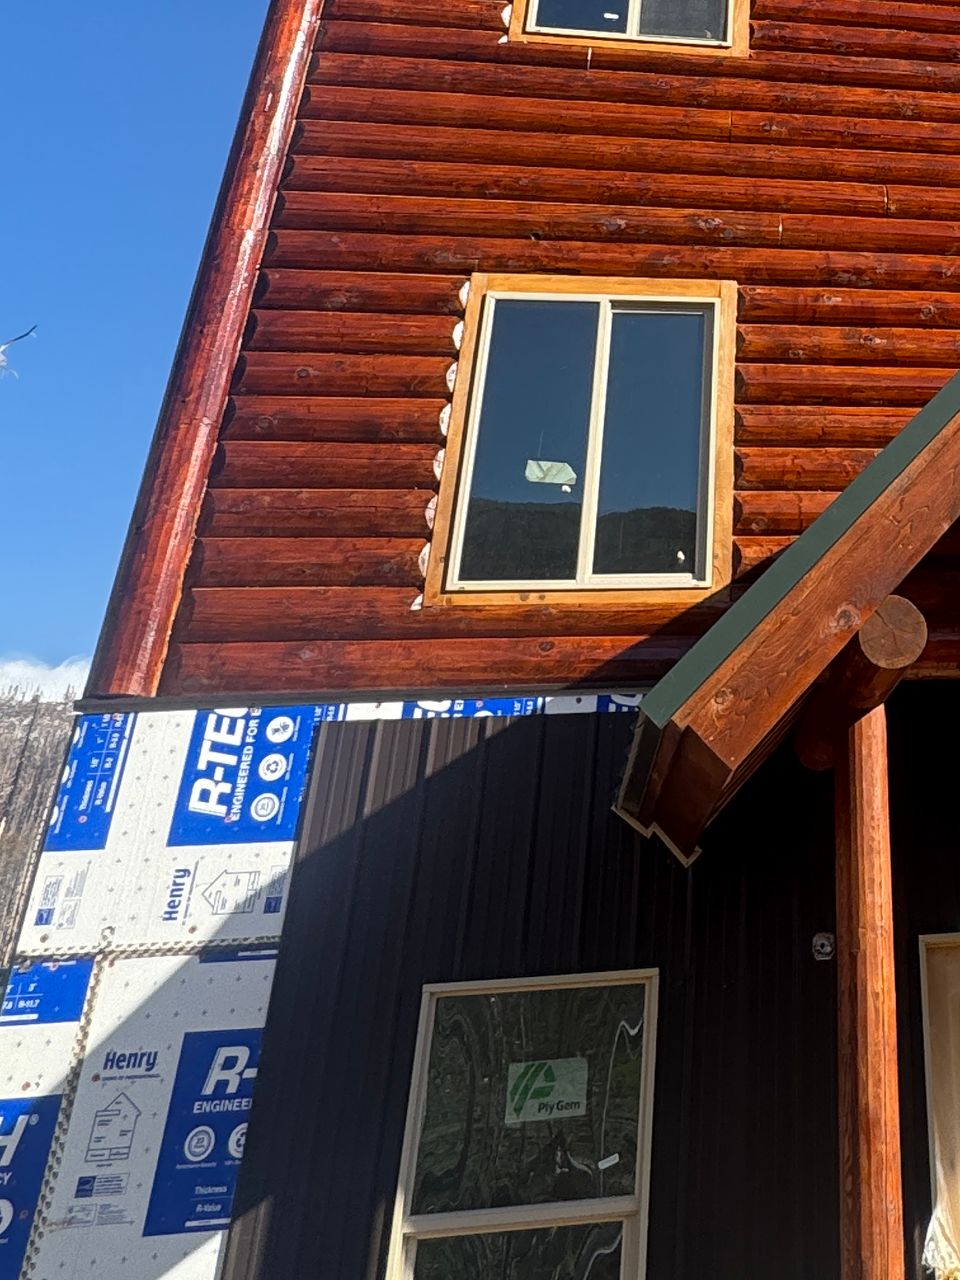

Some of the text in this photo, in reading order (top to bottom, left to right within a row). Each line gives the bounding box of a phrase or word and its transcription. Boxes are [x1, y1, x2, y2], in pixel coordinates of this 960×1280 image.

[188, 707, 248, 818] R-TE
[228, 745, 254, 821] ENGINEERED
[245, 718, 260, 743] FOR
[162, 868, 191, 921] Henry
[103, 1051, 158, 1072] Henry
[537, 1100, 581, 1115] Ply Gem
